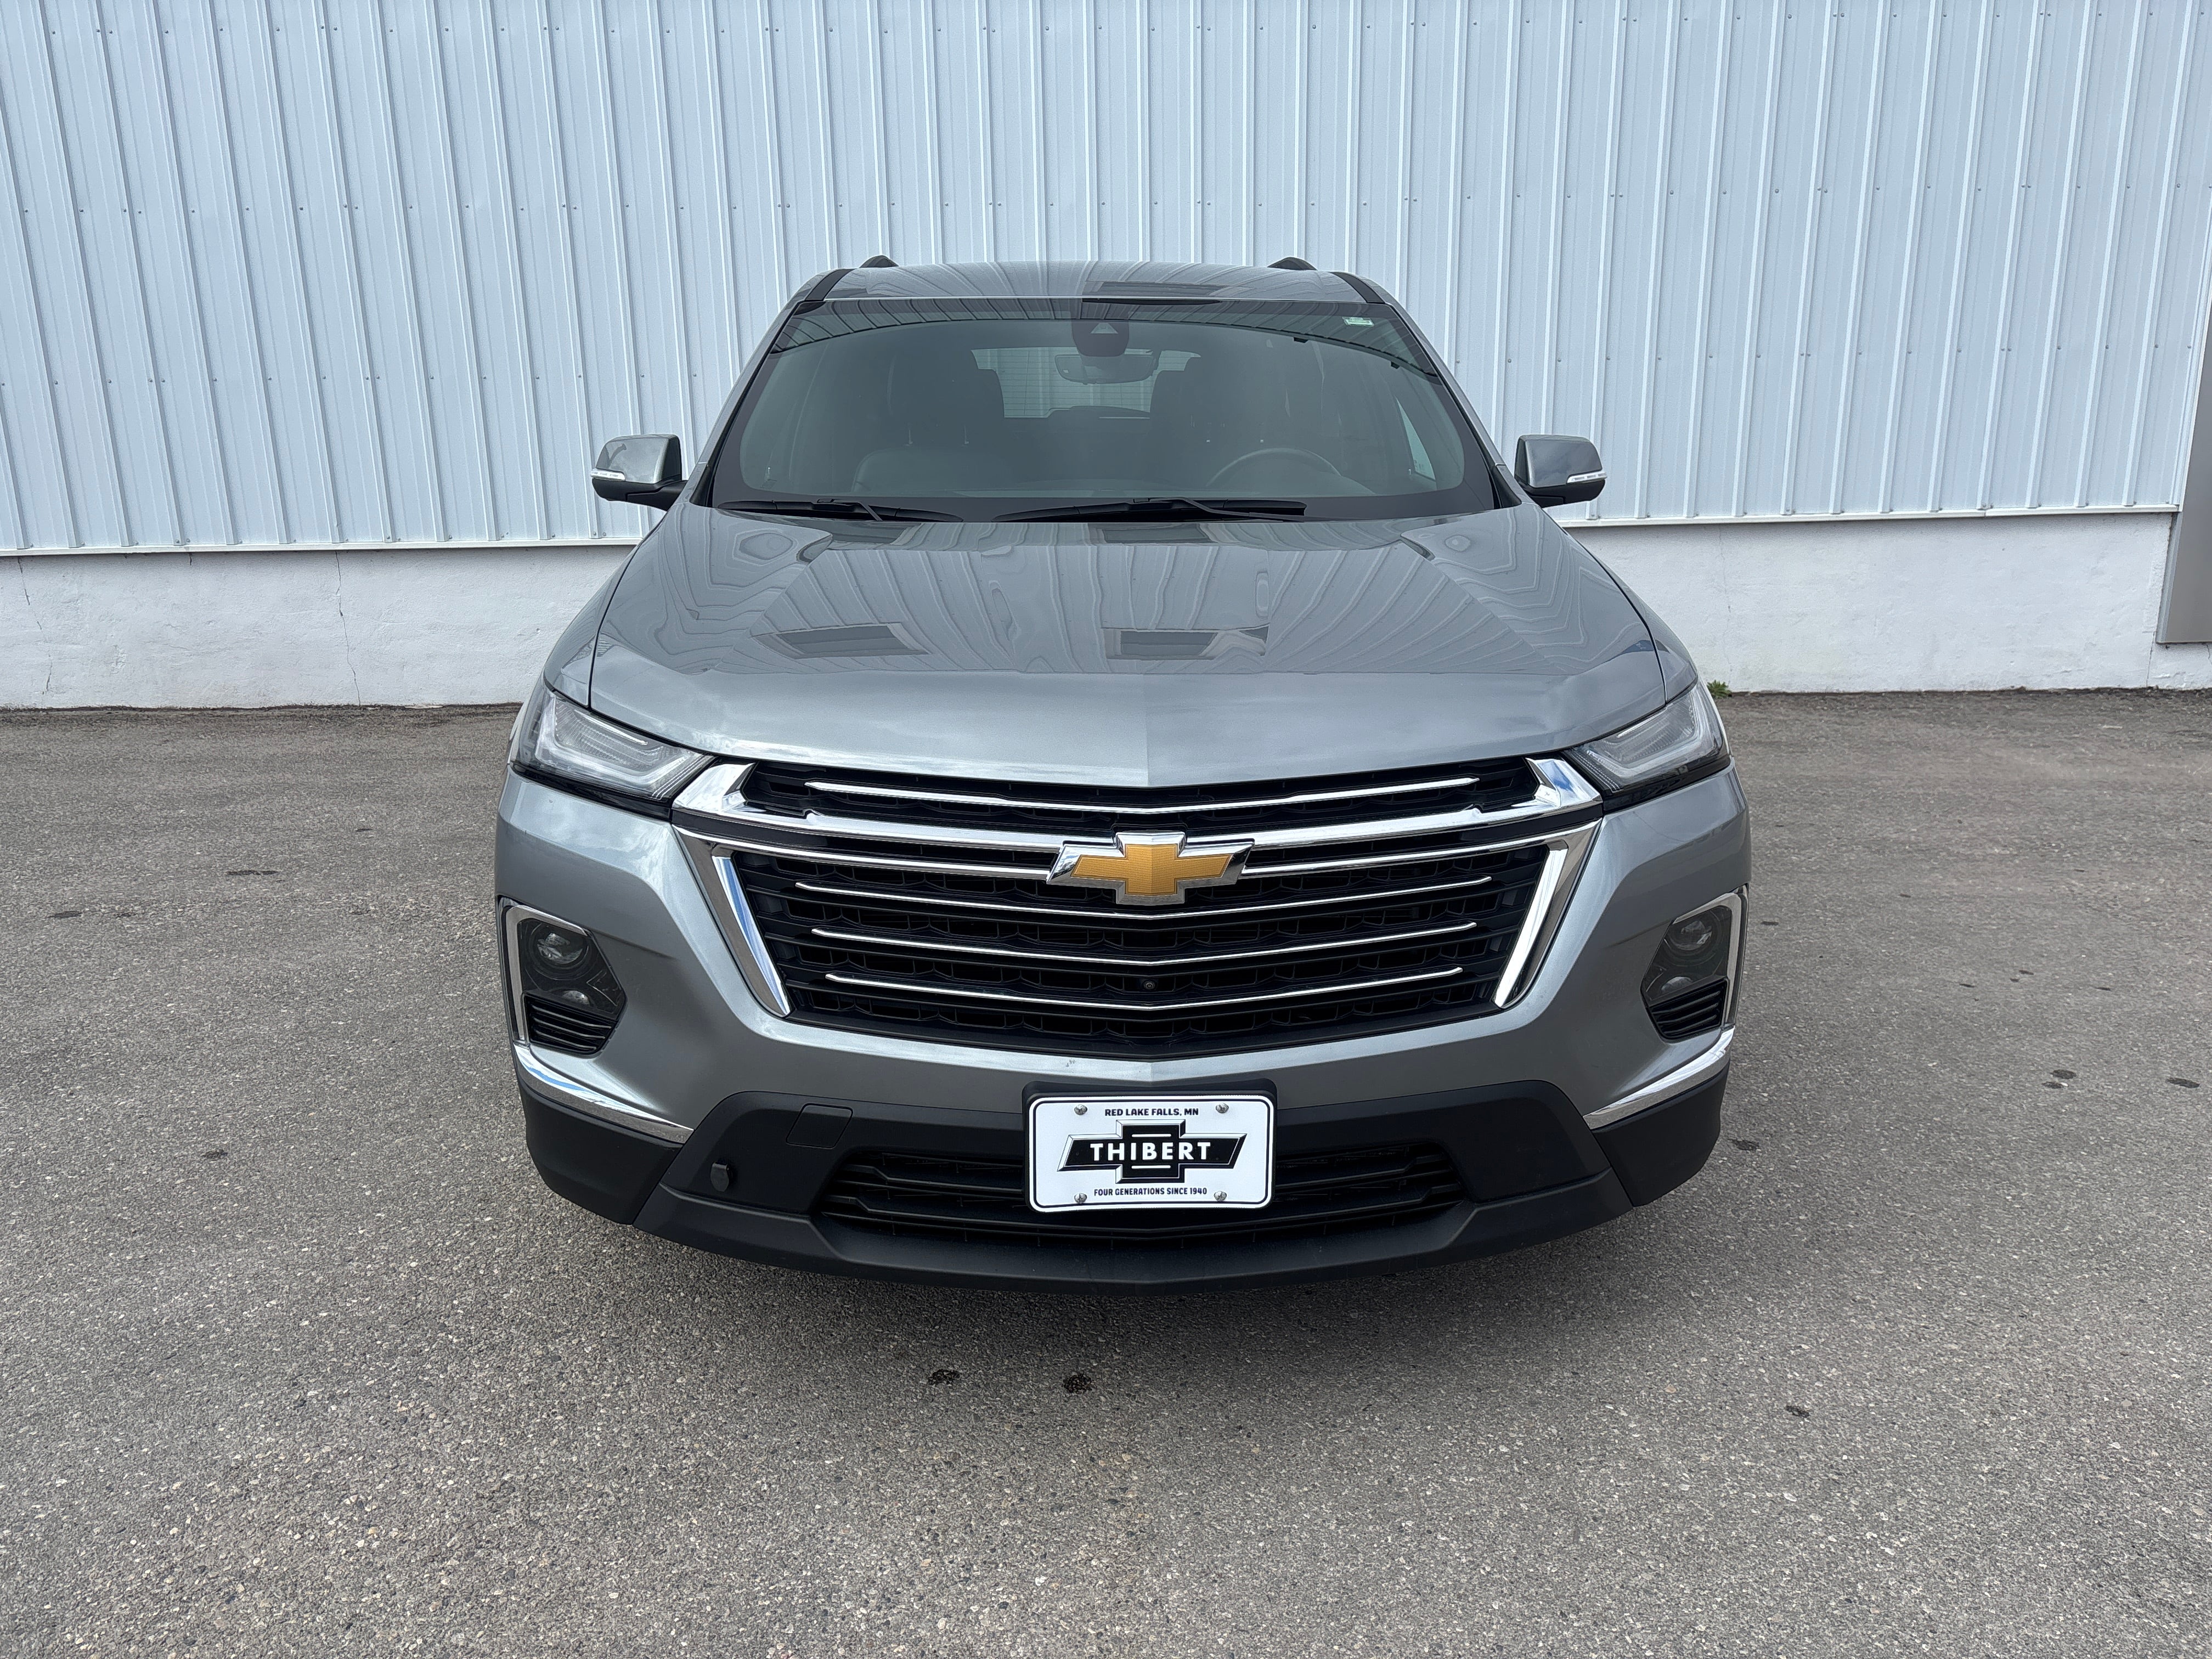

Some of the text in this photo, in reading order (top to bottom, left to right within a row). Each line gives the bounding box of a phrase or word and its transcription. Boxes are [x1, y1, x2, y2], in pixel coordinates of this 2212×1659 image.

[1151, 1108, 1182, 1116] FALLS,
[1184, 1108, 1199, 1116] MN
[1090, 1142, 1211, 1161] THIBERT
[1094, 1188, 1113, 1197] FOUR
[1115, 1187, 1165, 1196] GENERATIONS
